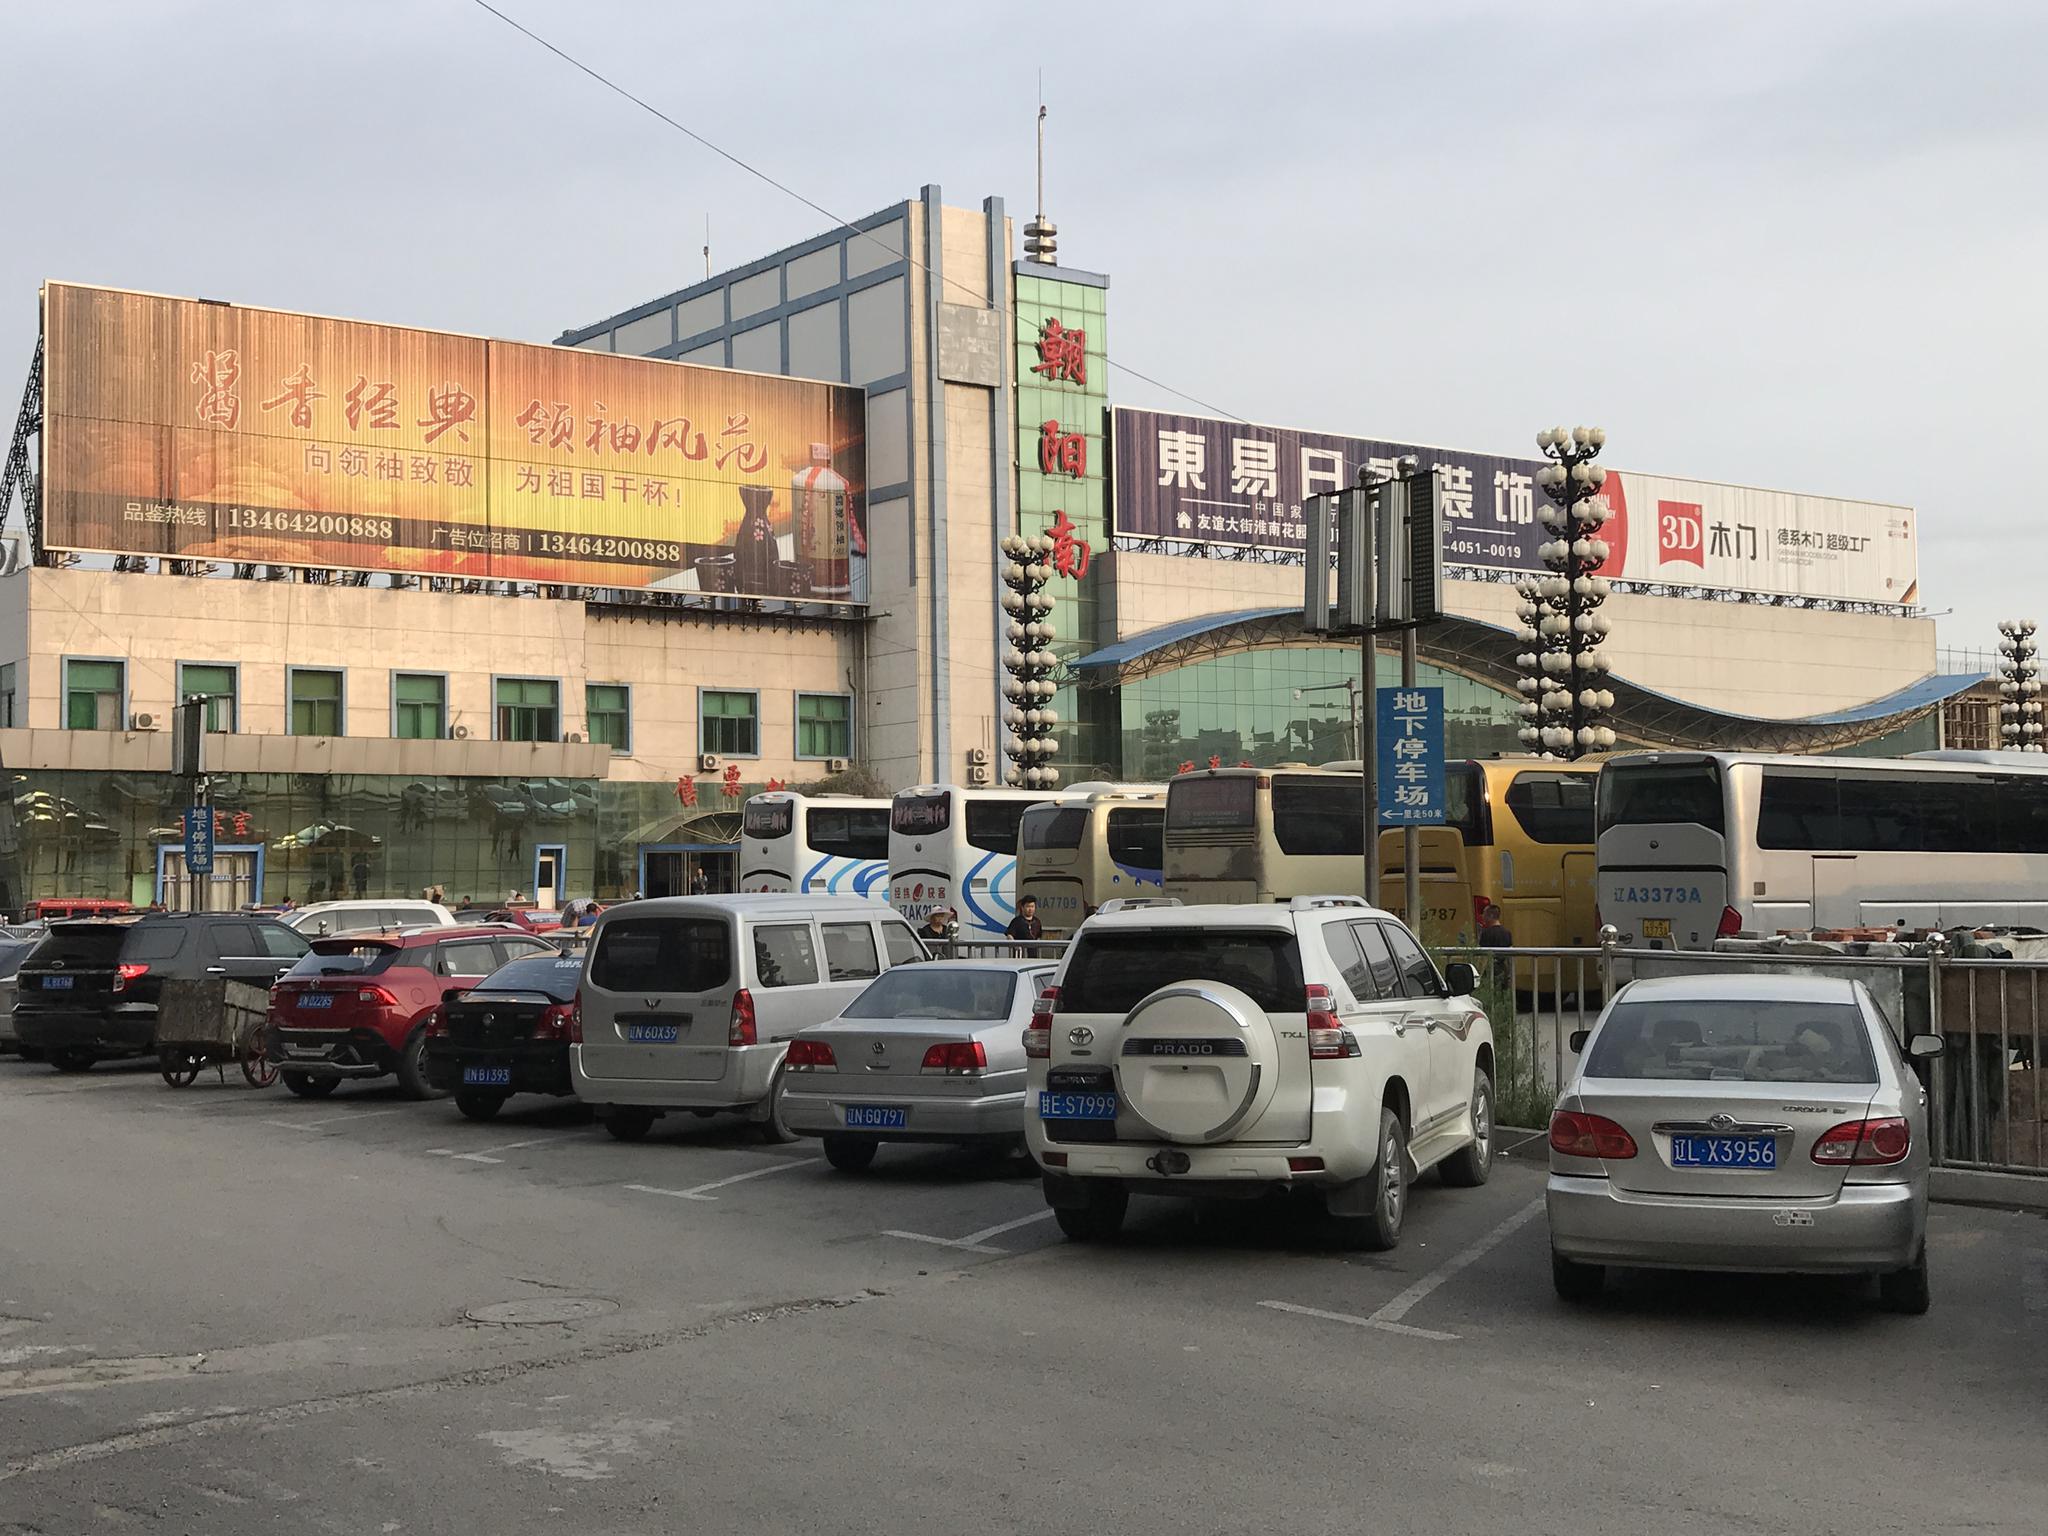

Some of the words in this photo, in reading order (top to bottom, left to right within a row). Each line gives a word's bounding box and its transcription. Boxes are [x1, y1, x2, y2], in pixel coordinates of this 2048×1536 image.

[515, 399, 768, 473] 领袖风范
[303, 444, 474, 487] 向领袖致敬
[123, 501, 207, 528] 品鉴热线
[228, 508, 393, 539] 13464200888
[1662, 515, 1700, 550] 3D
[430, 526, 521, 552] 广告位招商
[539, 533, 681, 562] 13464200888
[1709, 521, 1757, 561] 木门
[1777, 528, 1823, 549] 德系木门
[1826, 533, 1871, 552] 超级工厂
[1393, 691, 1429, 806] 地下停车场
[191, 808, 208, 865] 地下停车场
[1614, 887, 1702, 904] 辽A3373A
[1153, 1044, 1213, 1055] PRADO
